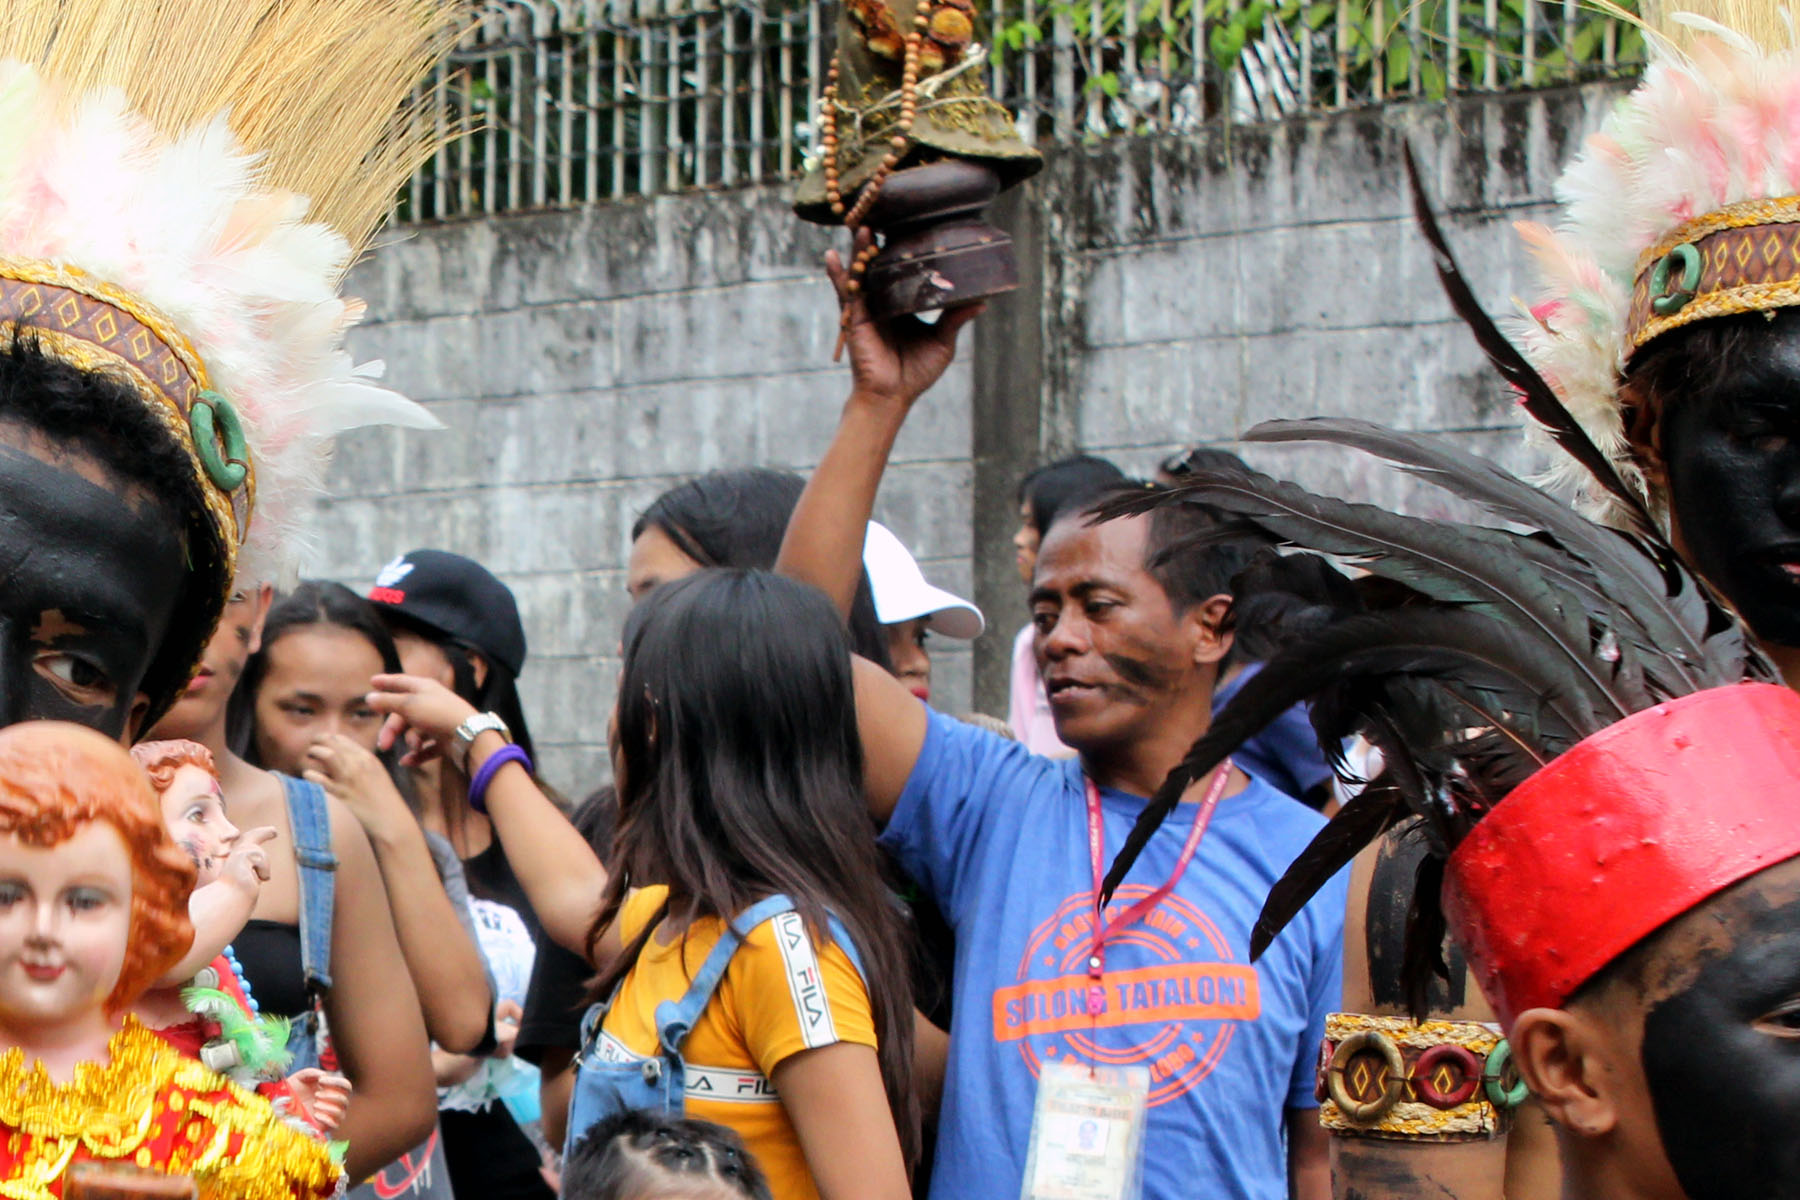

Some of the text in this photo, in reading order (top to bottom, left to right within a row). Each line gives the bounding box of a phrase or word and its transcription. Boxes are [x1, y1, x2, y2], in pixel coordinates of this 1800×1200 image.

[782, 913, 801, 950] ILA
[797, 966, 823, 1028] FILA
[1117, 975, 1247, 1013] TATALON!
[737, 1077, 778, 1095] FIL
